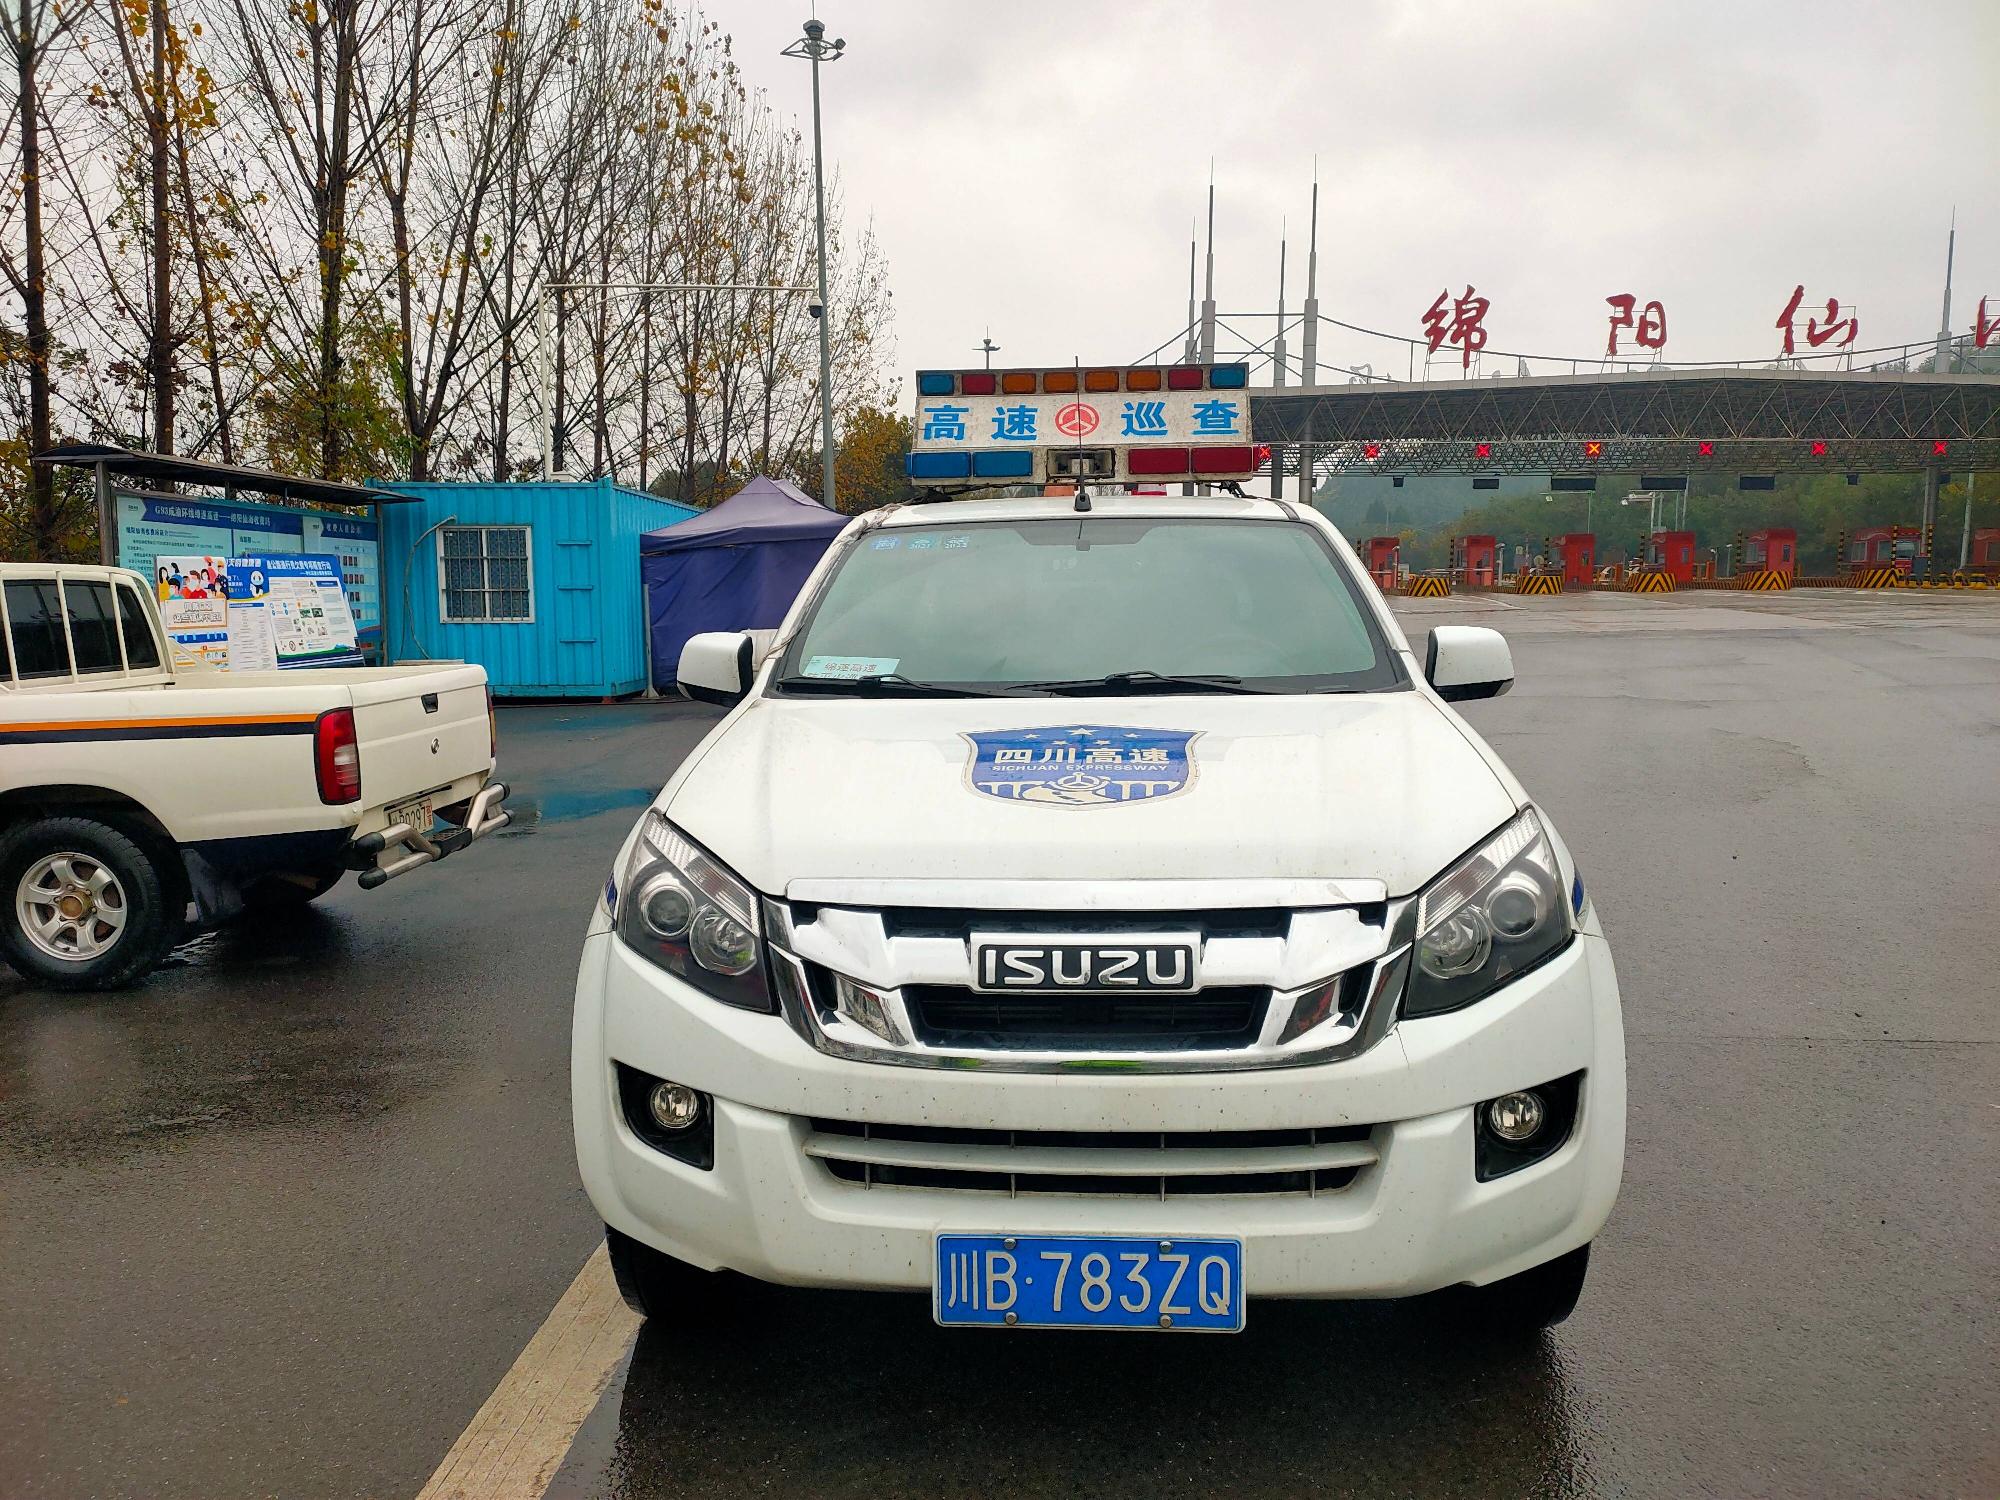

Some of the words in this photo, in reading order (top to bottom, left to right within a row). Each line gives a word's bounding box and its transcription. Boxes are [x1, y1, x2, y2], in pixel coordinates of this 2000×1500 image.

[923, 404, 1038, 441] 高速
[1121, 400, 1239, 437] 巡查
[994, 748, 1170, 764] 四川高速
[985, 949, 1186, 985] ISUZU
